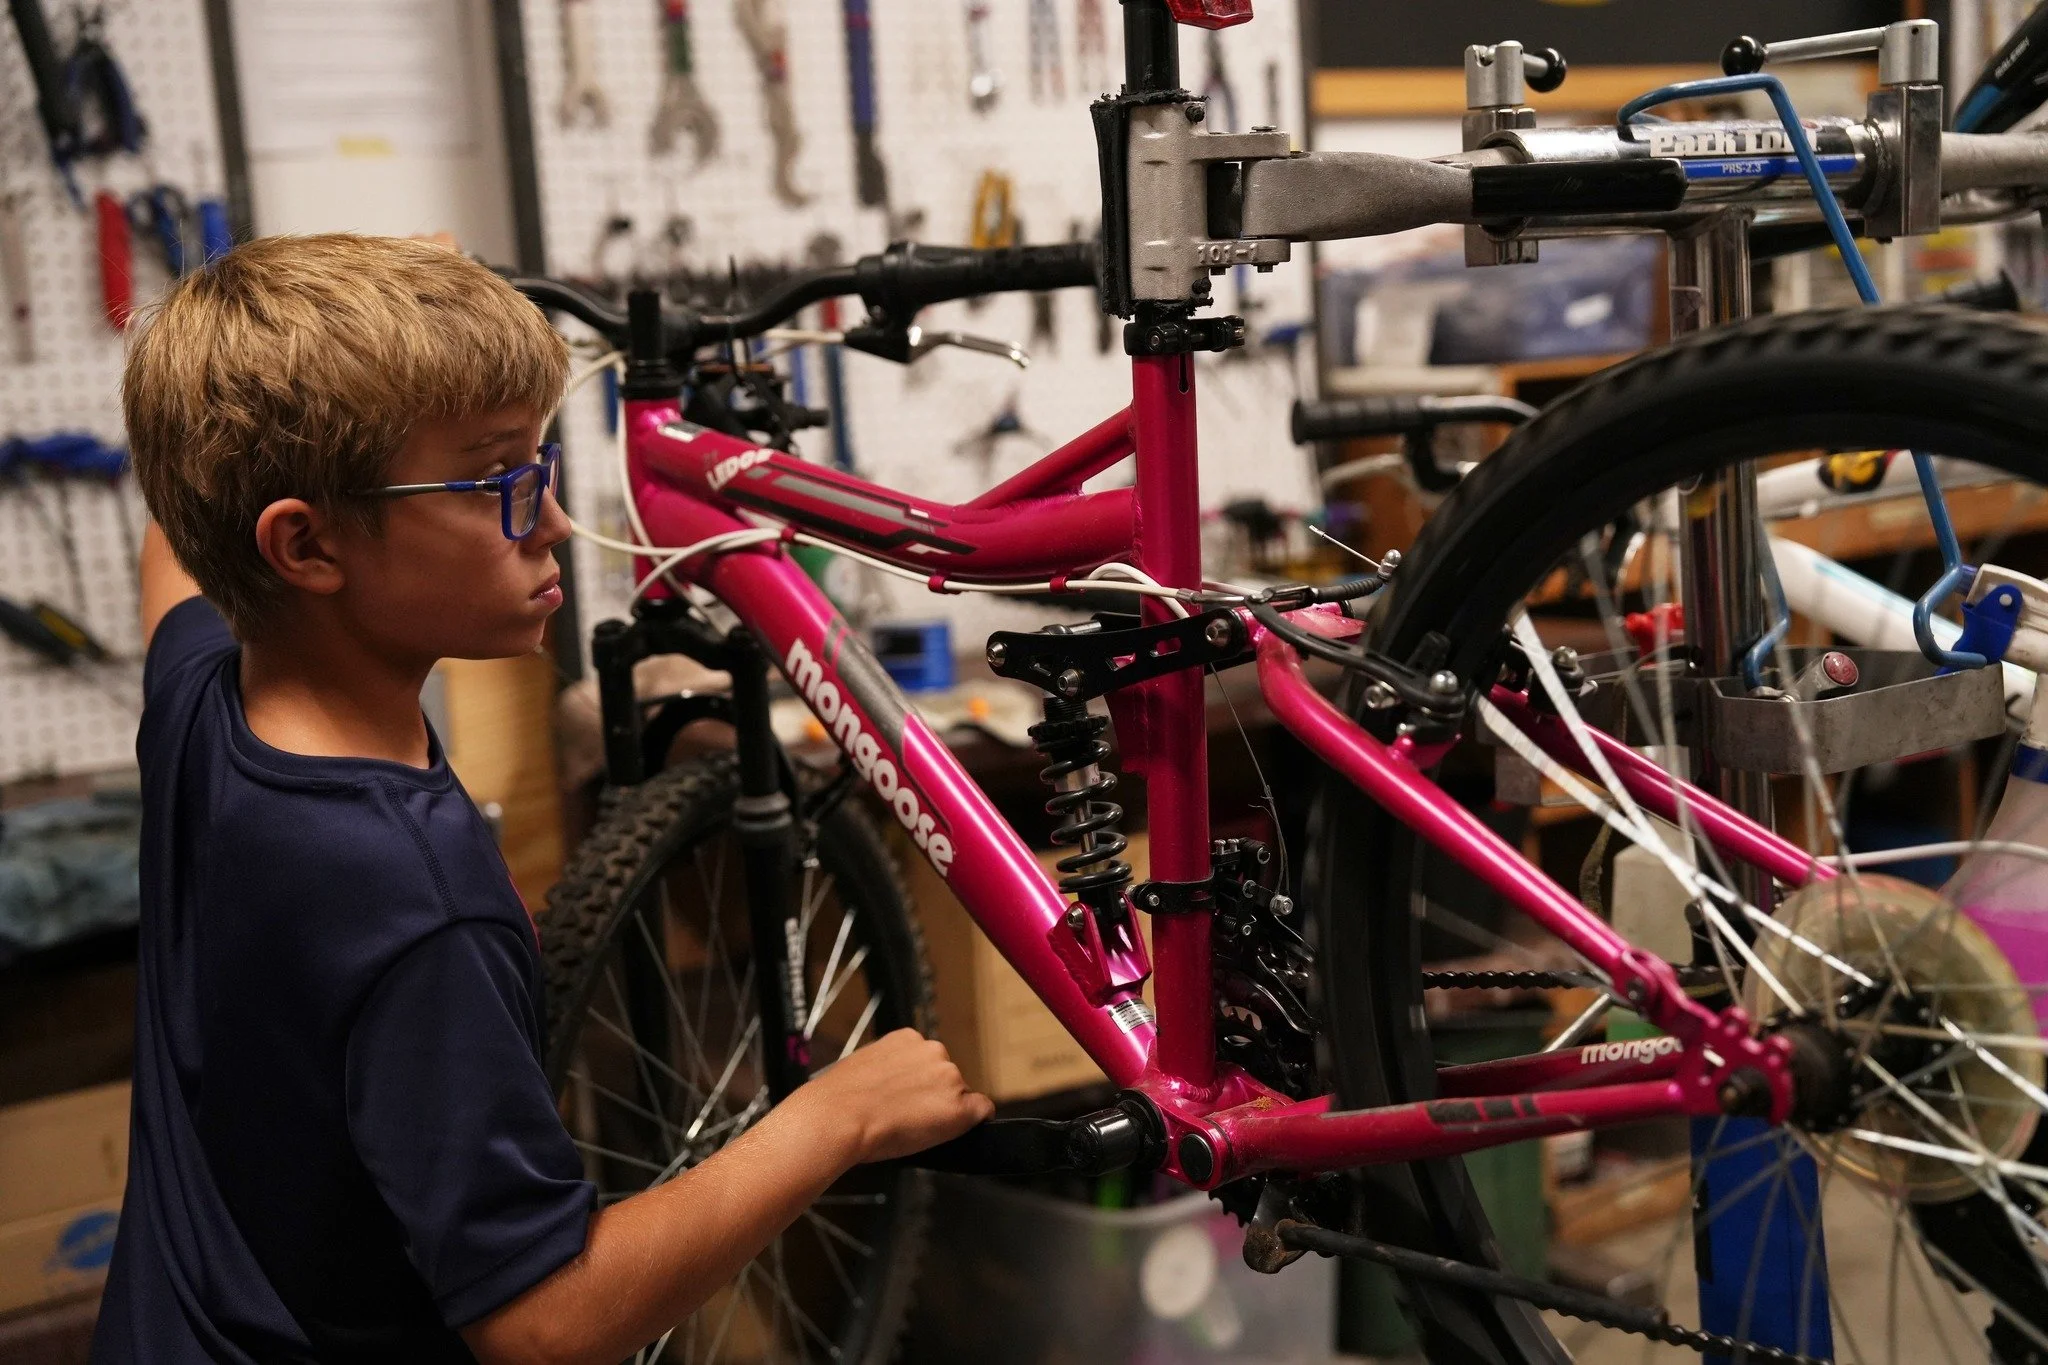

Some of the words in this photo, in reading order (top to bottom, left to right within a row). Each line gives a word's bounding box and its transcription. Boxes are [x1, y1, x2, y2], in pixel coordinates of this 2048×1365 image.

[1722, 162, 1762, 175] PRS-2.3
[1197, 242, 1259, 264] 101-1
[785, 637, 955, 878] mongoose
